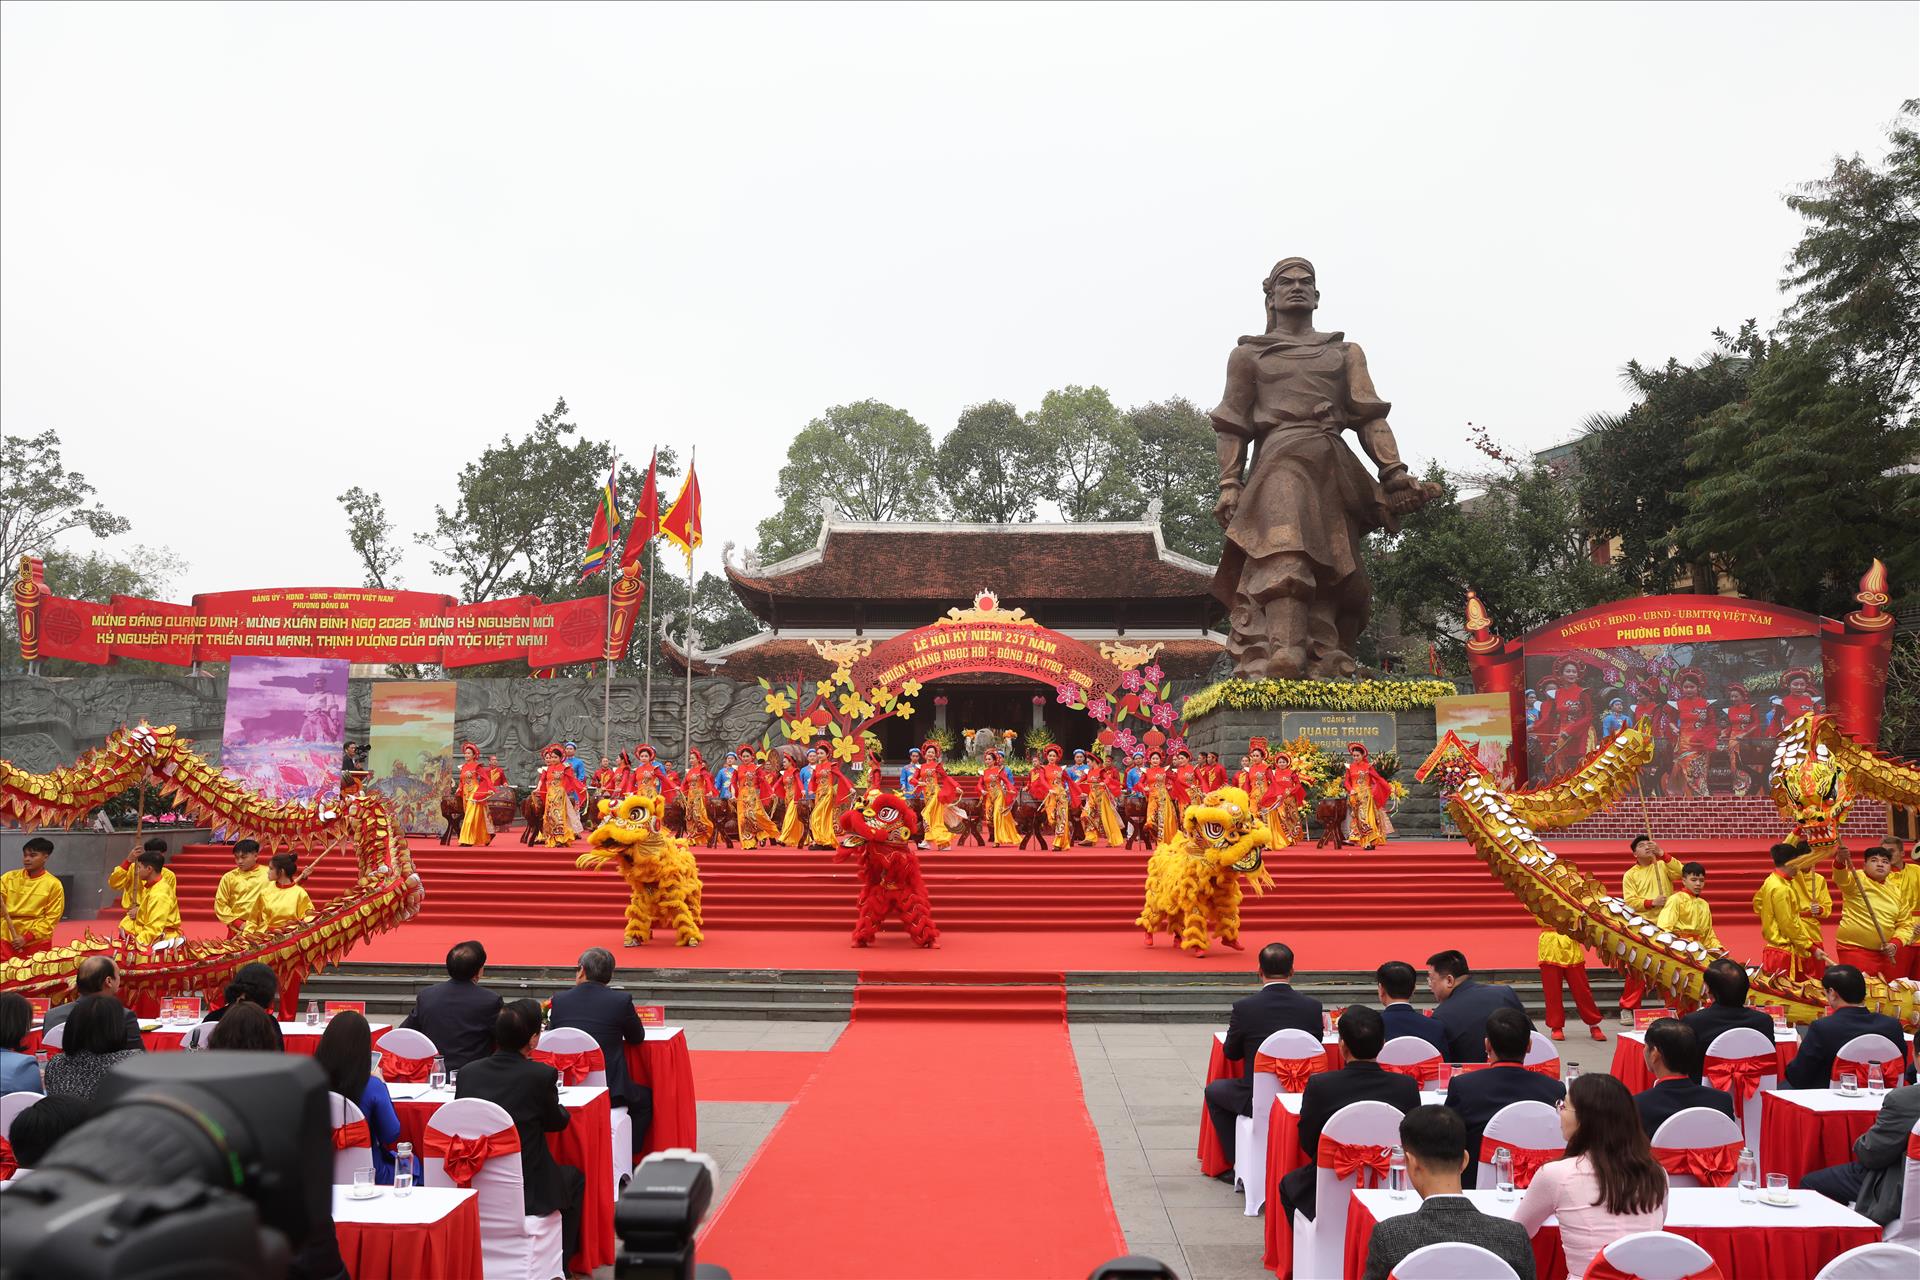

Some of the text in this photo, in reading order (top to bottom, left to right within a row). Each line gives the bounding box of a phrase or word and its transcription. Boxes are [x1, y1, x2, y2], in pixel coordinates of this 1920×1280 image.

[334, 593, 360, 602] UBMTTQ
[362, 593, 377, 602] VIỆT
[92, 612, 126, 626] MỪNG
[128, 612, 162, 627] ĐẢNG
[164, 616, 207, 628] QUANG
[210, 616, 238, 628] VINH
[246, 614, 280, 628] MỪNG
[283, 614, 317, 628] XUÂN
[320, 614, 348, 628] BÍNH
[351, 618, 376, 631] NGỌ
[378, 618, 410, 628] 2026
[420, 614, 454, 628] MỪNG
[457, 614, 475, 628] KỶ
[478, 614, 530, 628] NGUYÊN
[532, 614, 554, 628] MỚI
[1561, 624, 1587, 638] ĐẢNG
[1589, 618, 1601, 629] ỦY
[1608, 613, 1636, 625] HĐND
[1644, 610, 1670, 620] UBND
[1678, 610, 1720, 621] UBMTTQ
[1723, 610, 1748, 623] VIỆT
[1748, 614, 1772, 626] NAM
[96, 630, 114, 644] KỶ
[116, 630, 168, 644] NGUYÊN
[171, 630, 203, 645] PHÁT
[206, 630, 242, 645] TRIỂN
[245, 632, 274, 646] GIÀU
[276, 634, 313, 649] MẠNH,
[316, 635, 353, 649] THỊNH
[356, 634, 398, 649] VƯỢNG
[400, 632, 426, 646] CỦA
[428, 632, 454, 646] DÂN
[456, 632, 482, 648] TỘC
[484, 632, 513, 648] VIỆT
[1005, 632, 1027, 645] 237
[1617, 623, 1712, 640] PHƯỜNG ĐỐNG ĐA
[1025, 652, 1038, 666] ĐA
[1040, 658, 1063, 674] (1789
[1068, 669, 1093, 688] 2026)
[1299, 726, 1379, 737] QUANG TRUNG
